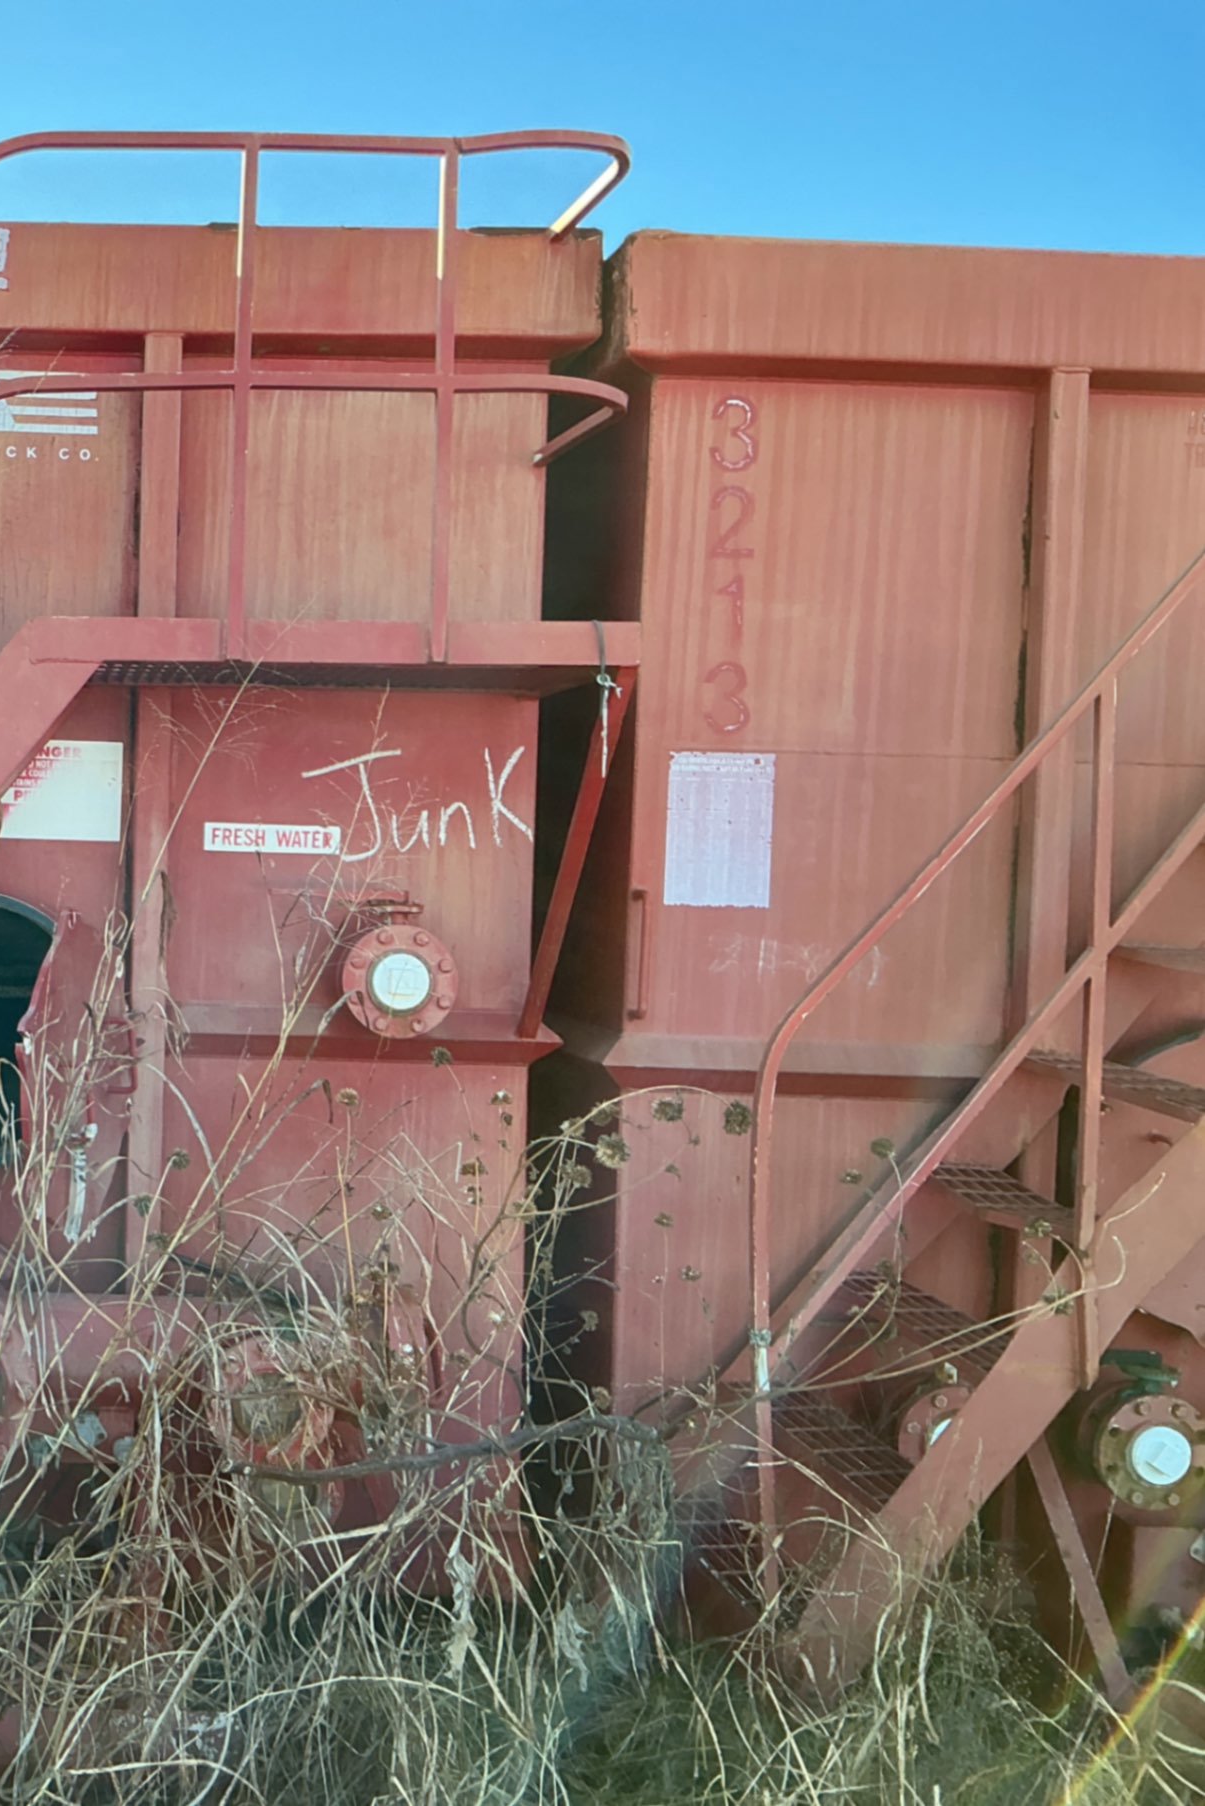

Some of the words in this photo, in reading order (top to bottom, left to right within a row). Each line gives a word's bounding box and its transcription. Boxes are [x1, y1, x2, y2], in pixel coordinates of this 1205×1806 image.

[35, 746, 82, 759] NGER
[210, 826, 266, 848] FRESH
[275, 830, 334, 850] WATER
